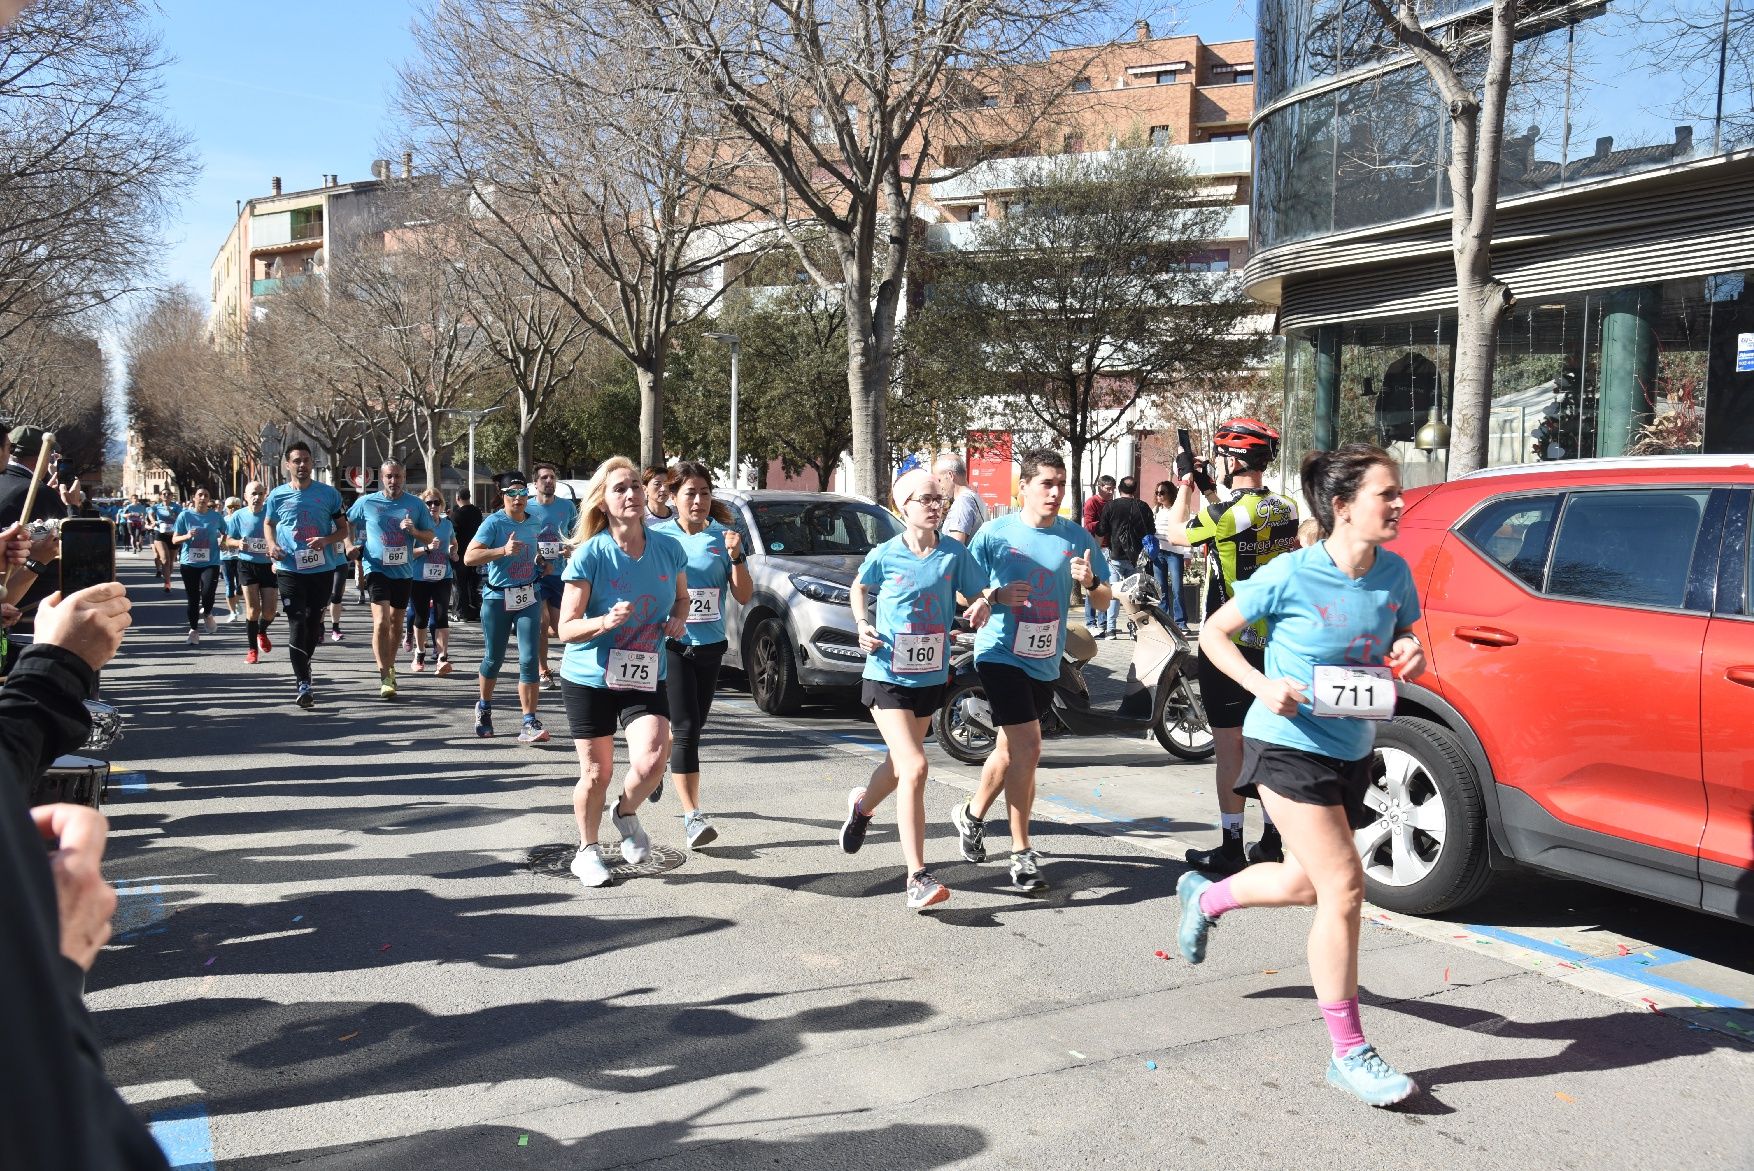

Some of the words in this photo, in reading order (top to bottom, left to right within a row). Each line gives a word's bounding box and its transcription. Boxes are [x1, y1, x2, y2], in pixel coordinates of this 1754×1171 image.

[1239, 540, 1271, 552] Berga
[388, 552, 404, 561] 697
[429, 568, 442, 576] 172
[515, 593, 528, 605] 36
[1028, 633, 1053, 649] 159
[906, 646, 935, 662] 160
[620, 662, 649, 680] 175
[1332, 685, 1373, 706] 711
